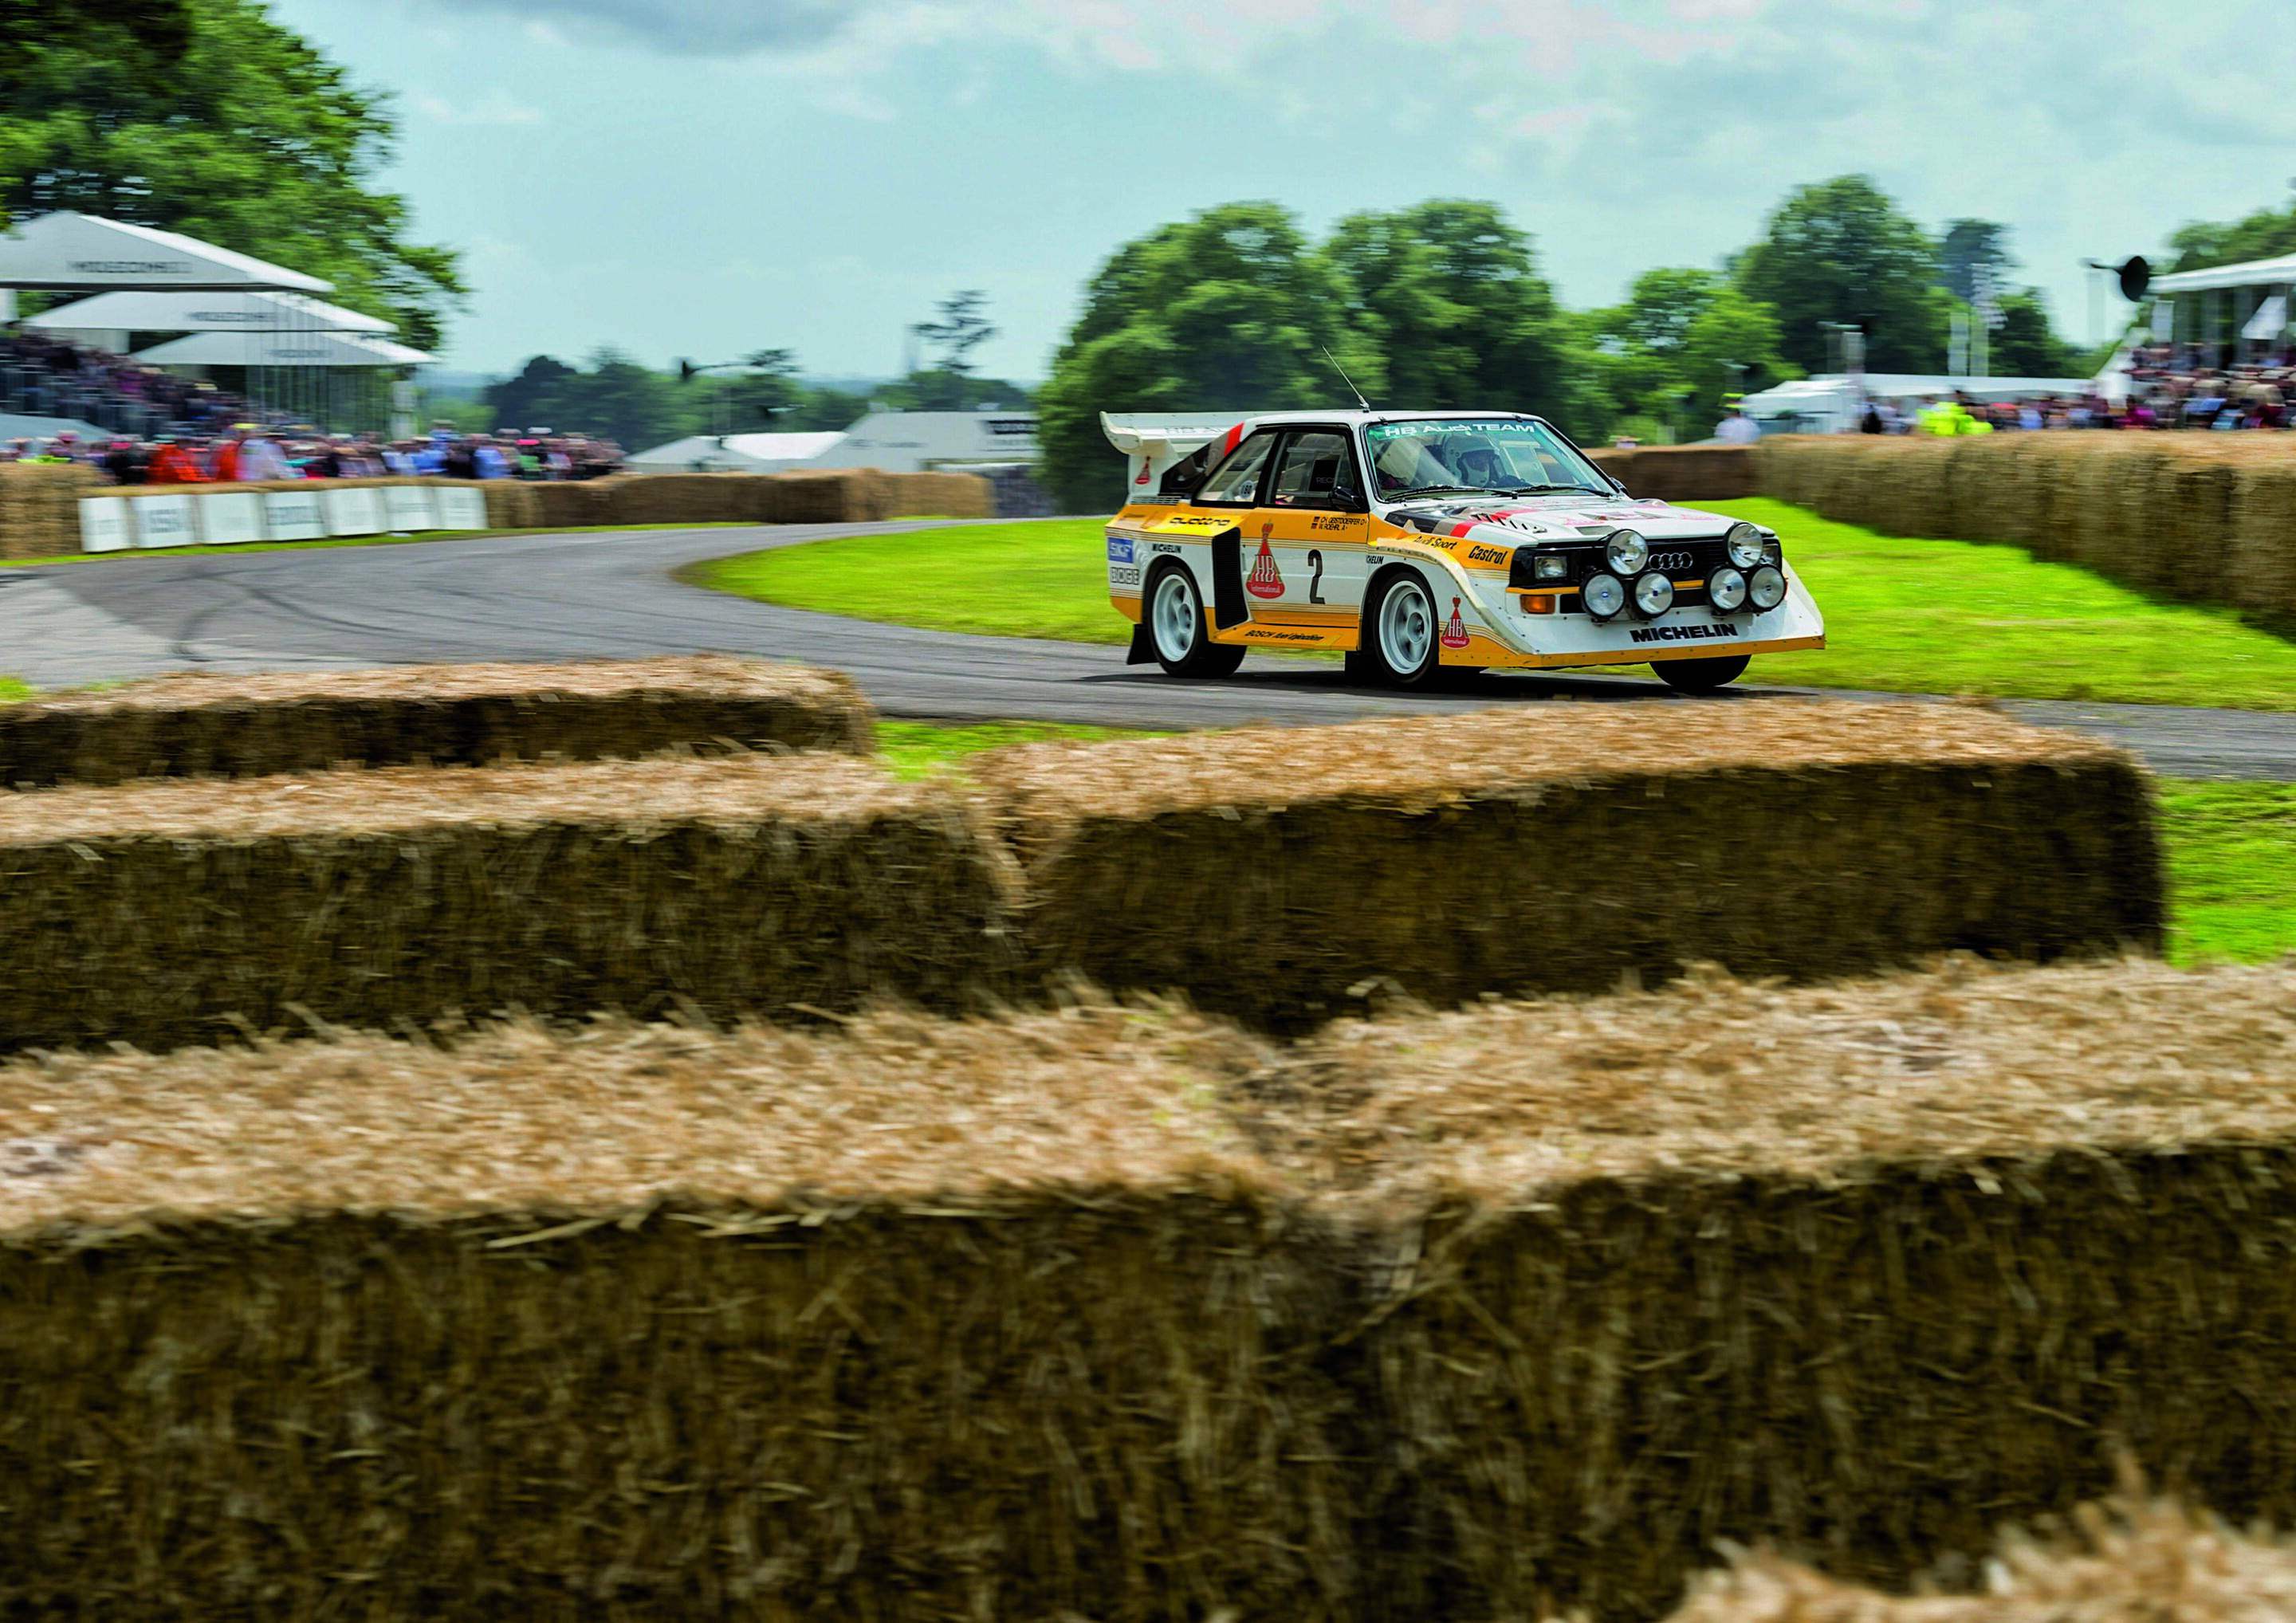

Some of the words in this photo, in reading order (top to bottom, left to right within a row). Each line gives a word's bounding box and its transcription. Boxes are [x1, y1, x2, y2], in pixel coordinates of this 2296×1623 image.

[1385, 426, 1417, 437] HB
[1472, 423, 1535, 433] TEAM
[1153, 543, 1182, 554] MICHELIN
[1431, 538, 1457, 550] Sport
[1468, 545, 1508, 565] Castrol
[1255, 555, 1276, 583] HB
[1307, 548, 1326, 605] 2
[1448, 618, 1464, 638] HB
[1630, 623, 1739, 643] MICHELIN
